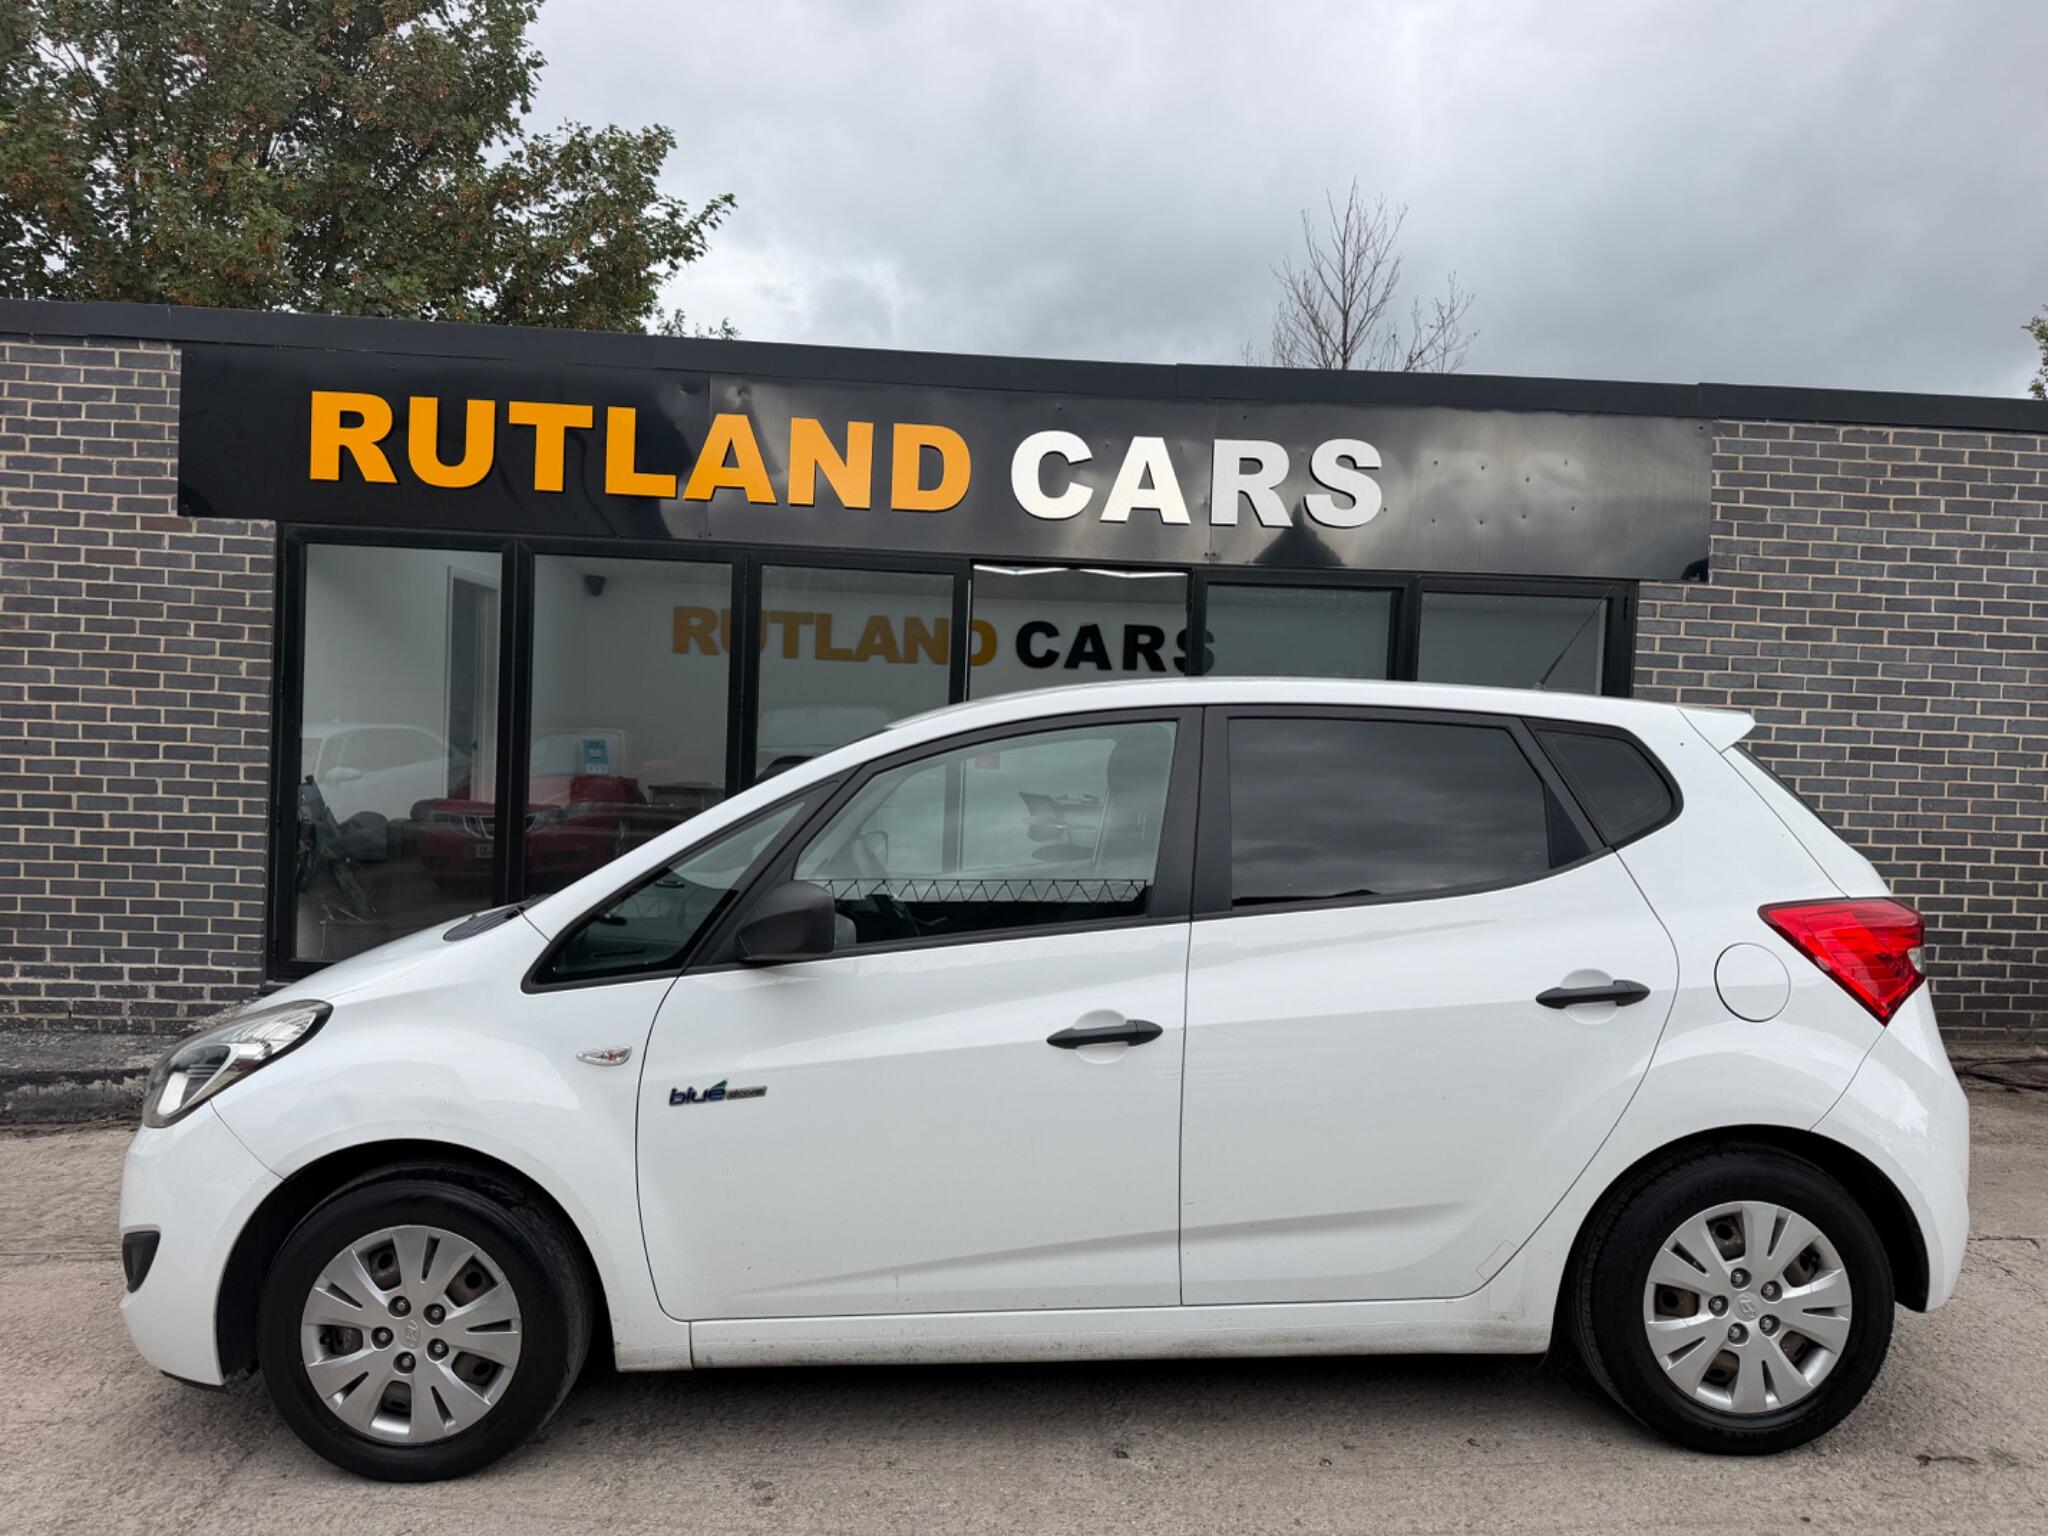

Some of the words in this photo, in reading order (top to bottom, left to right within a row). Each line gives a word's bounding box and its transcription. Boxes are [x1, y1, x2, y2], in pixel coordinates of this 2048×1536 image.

[309, 390, 972, 512] RUTLAND
[1010, 430, 1383, 528] CARS
[669, 1085, 726, 1106] blue
